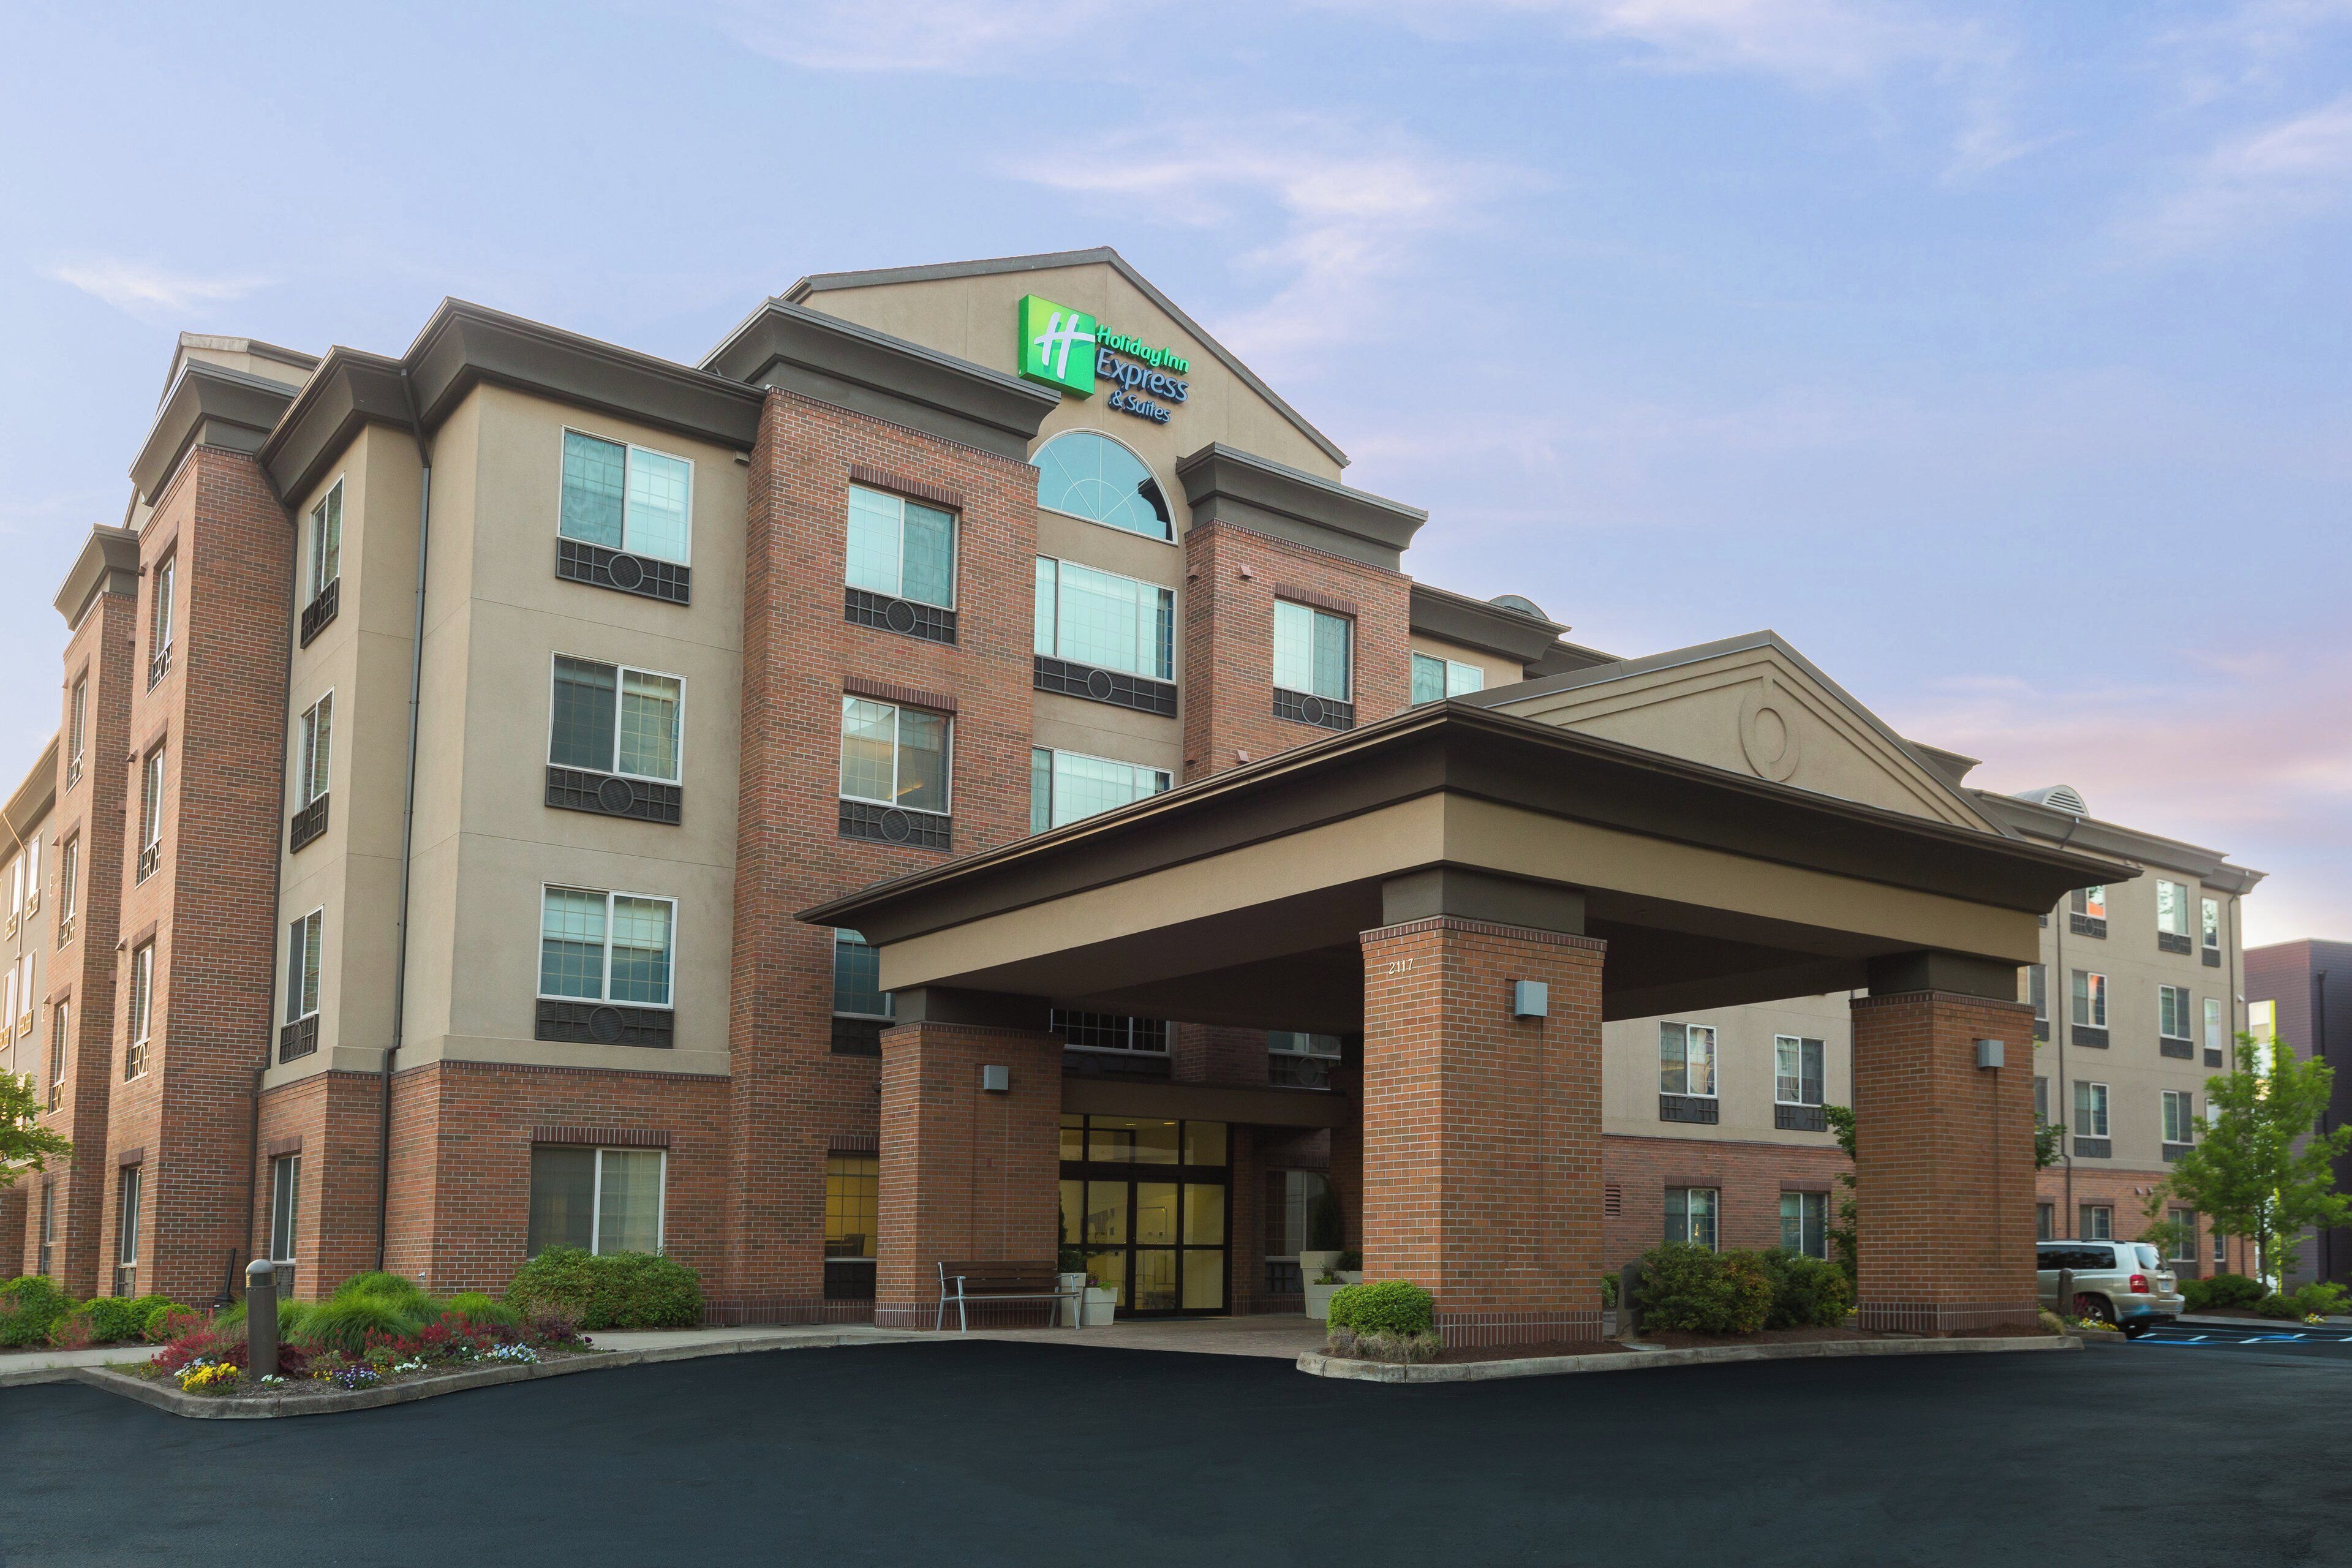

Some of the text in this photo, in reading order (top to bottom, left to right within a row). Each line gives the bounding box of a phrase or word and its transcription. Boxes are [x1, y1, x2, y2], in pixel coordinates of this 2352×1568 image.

[1096, 324, 1190, 374] Holiday Inn
[1096, 347, 1189, 402] Express
[1112, 390, 1171, 422] & Suites
[1389, 958, 1414, 974] 2117
